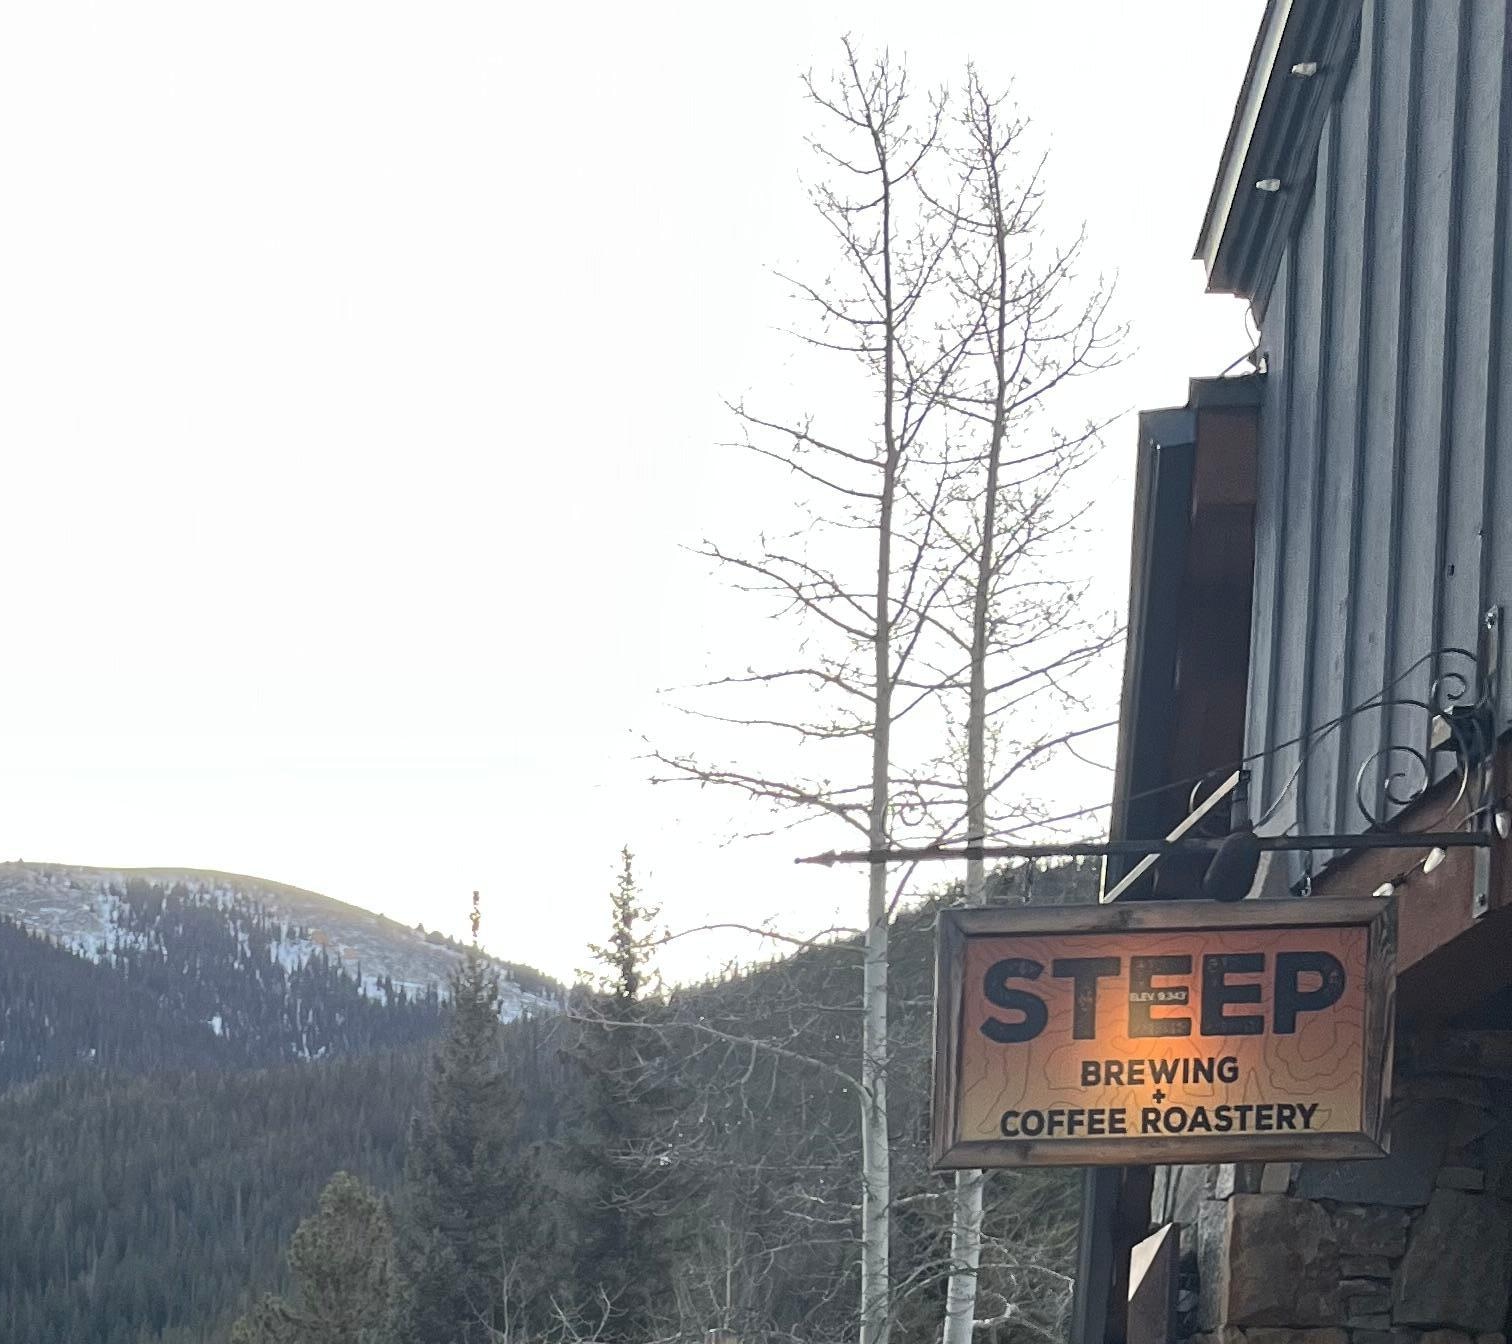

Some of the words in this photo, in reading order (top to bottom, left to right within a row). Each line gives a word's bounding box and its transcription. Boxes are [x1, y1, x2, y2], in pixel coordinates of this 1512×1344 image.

[979, 951, 1346, 1043] STEEP
[1080, 1056, 1240, 1087] BREWING
[999, 1107, 1128, 1137] COFFEE
[1141, 1103, 1320, 1134] ROASTERY
